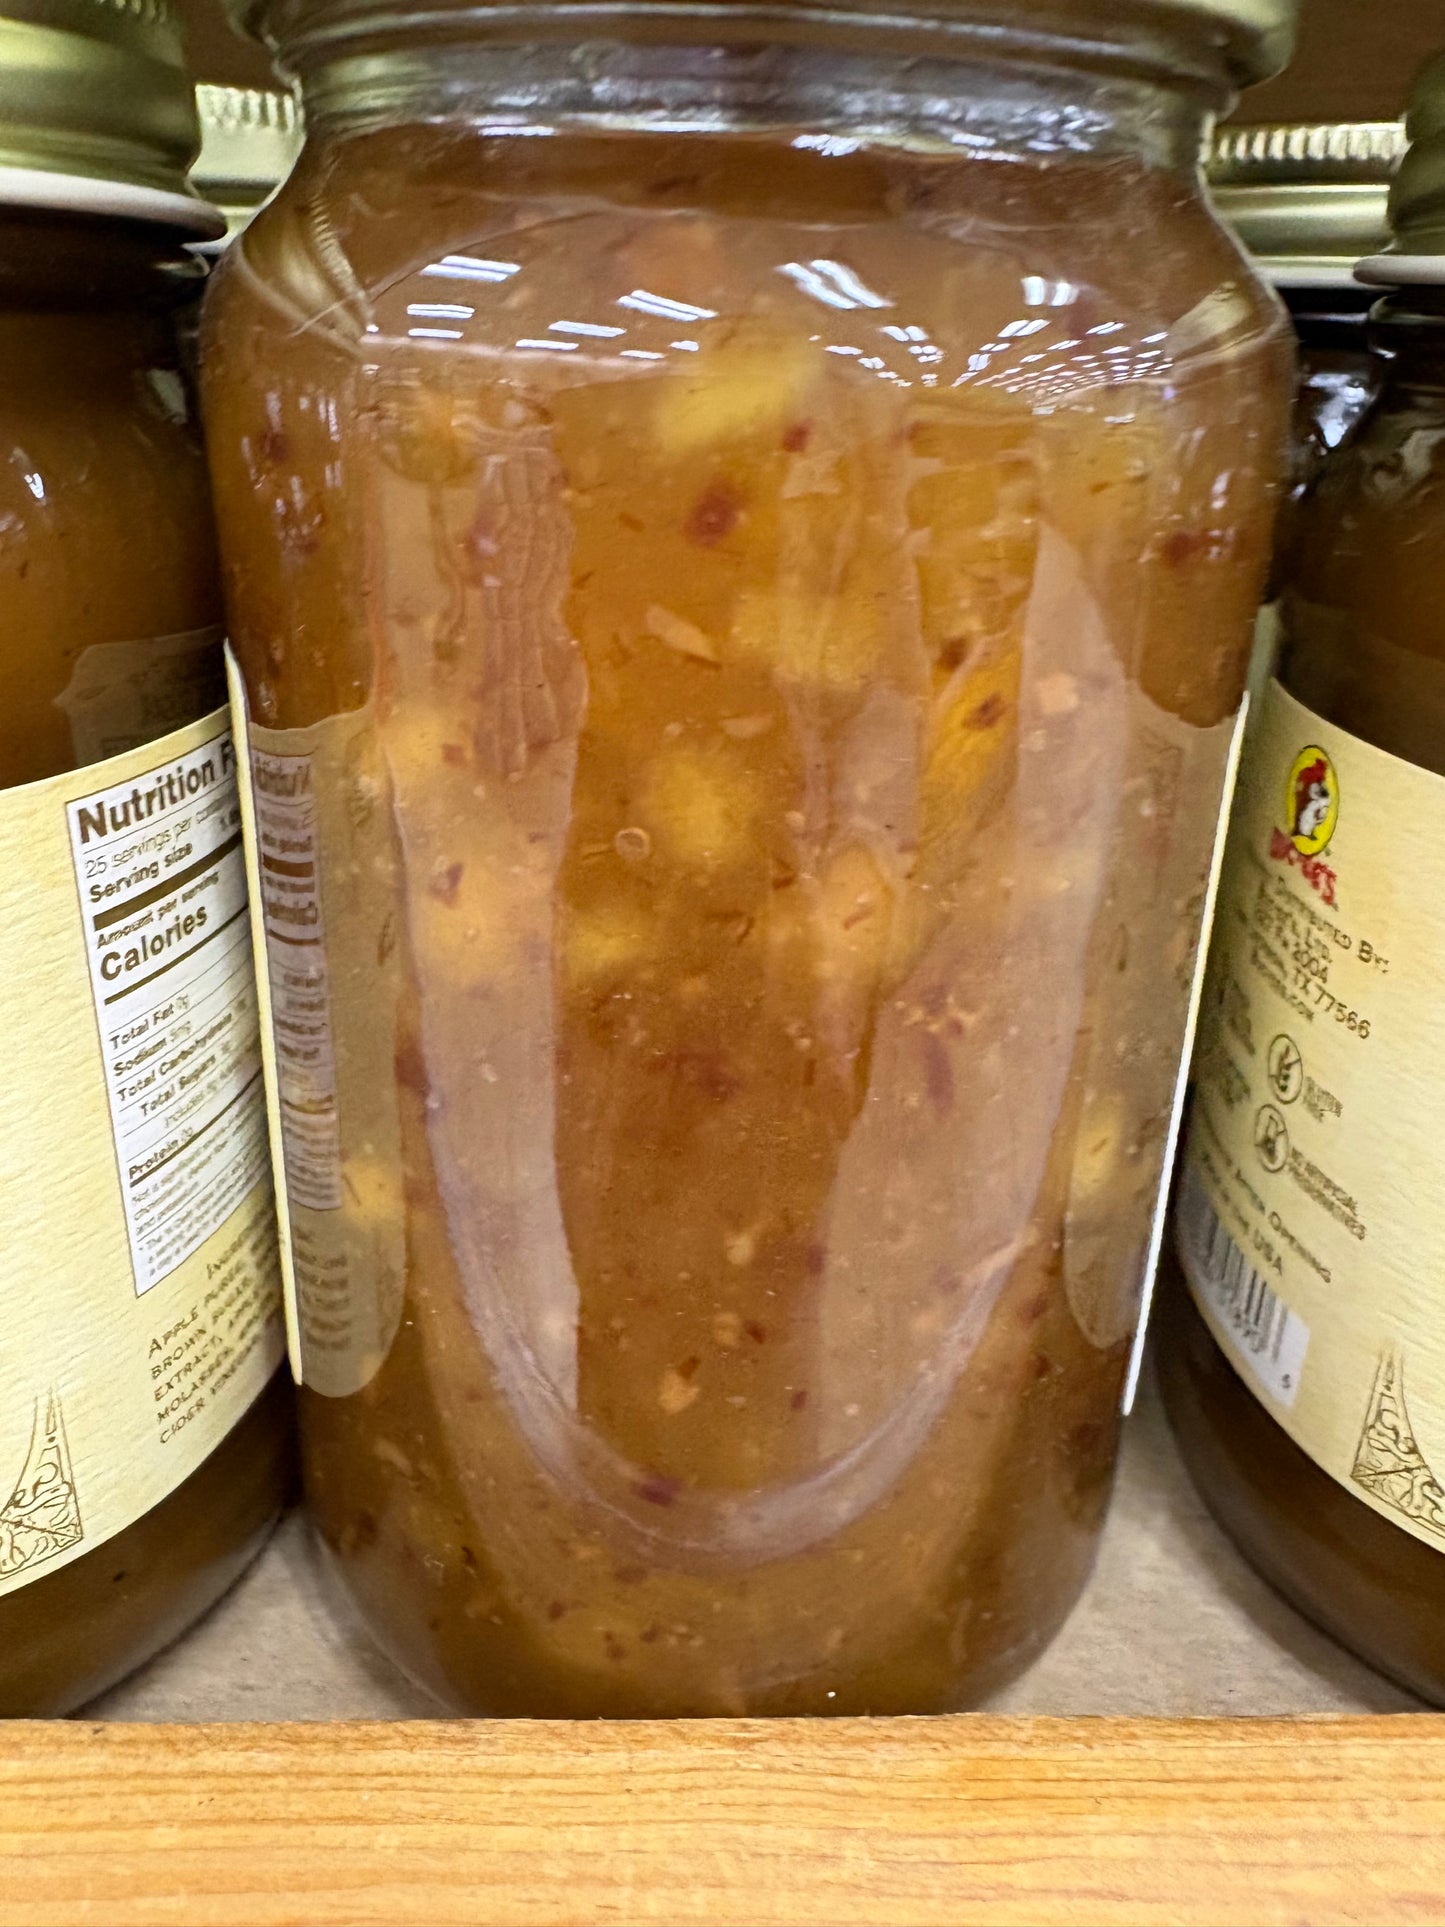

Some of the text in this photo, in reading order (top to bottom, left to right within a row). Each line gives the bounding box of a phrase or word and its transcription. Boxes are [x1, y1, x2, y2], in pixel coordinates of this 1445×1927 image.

[78, 758, 215, 844] Nutrition
[86, 856, 107, 878] 25
[111, 829, 172, 868] servings
[90, 841, 193, 903] Serving size
[97, 912, 153, 949] Amount
[100, 904, 207, 981] Calories
[109, 1019, 149, 1050] Total
[153, 1003, 175, 1027] Fat
[113, 1038, 167, 1077] Sodium
[118, 1070, 156, 1102] Total
[140, 1085, 175, 1117] Total
[128, 1137, 179, 1180] Protein
